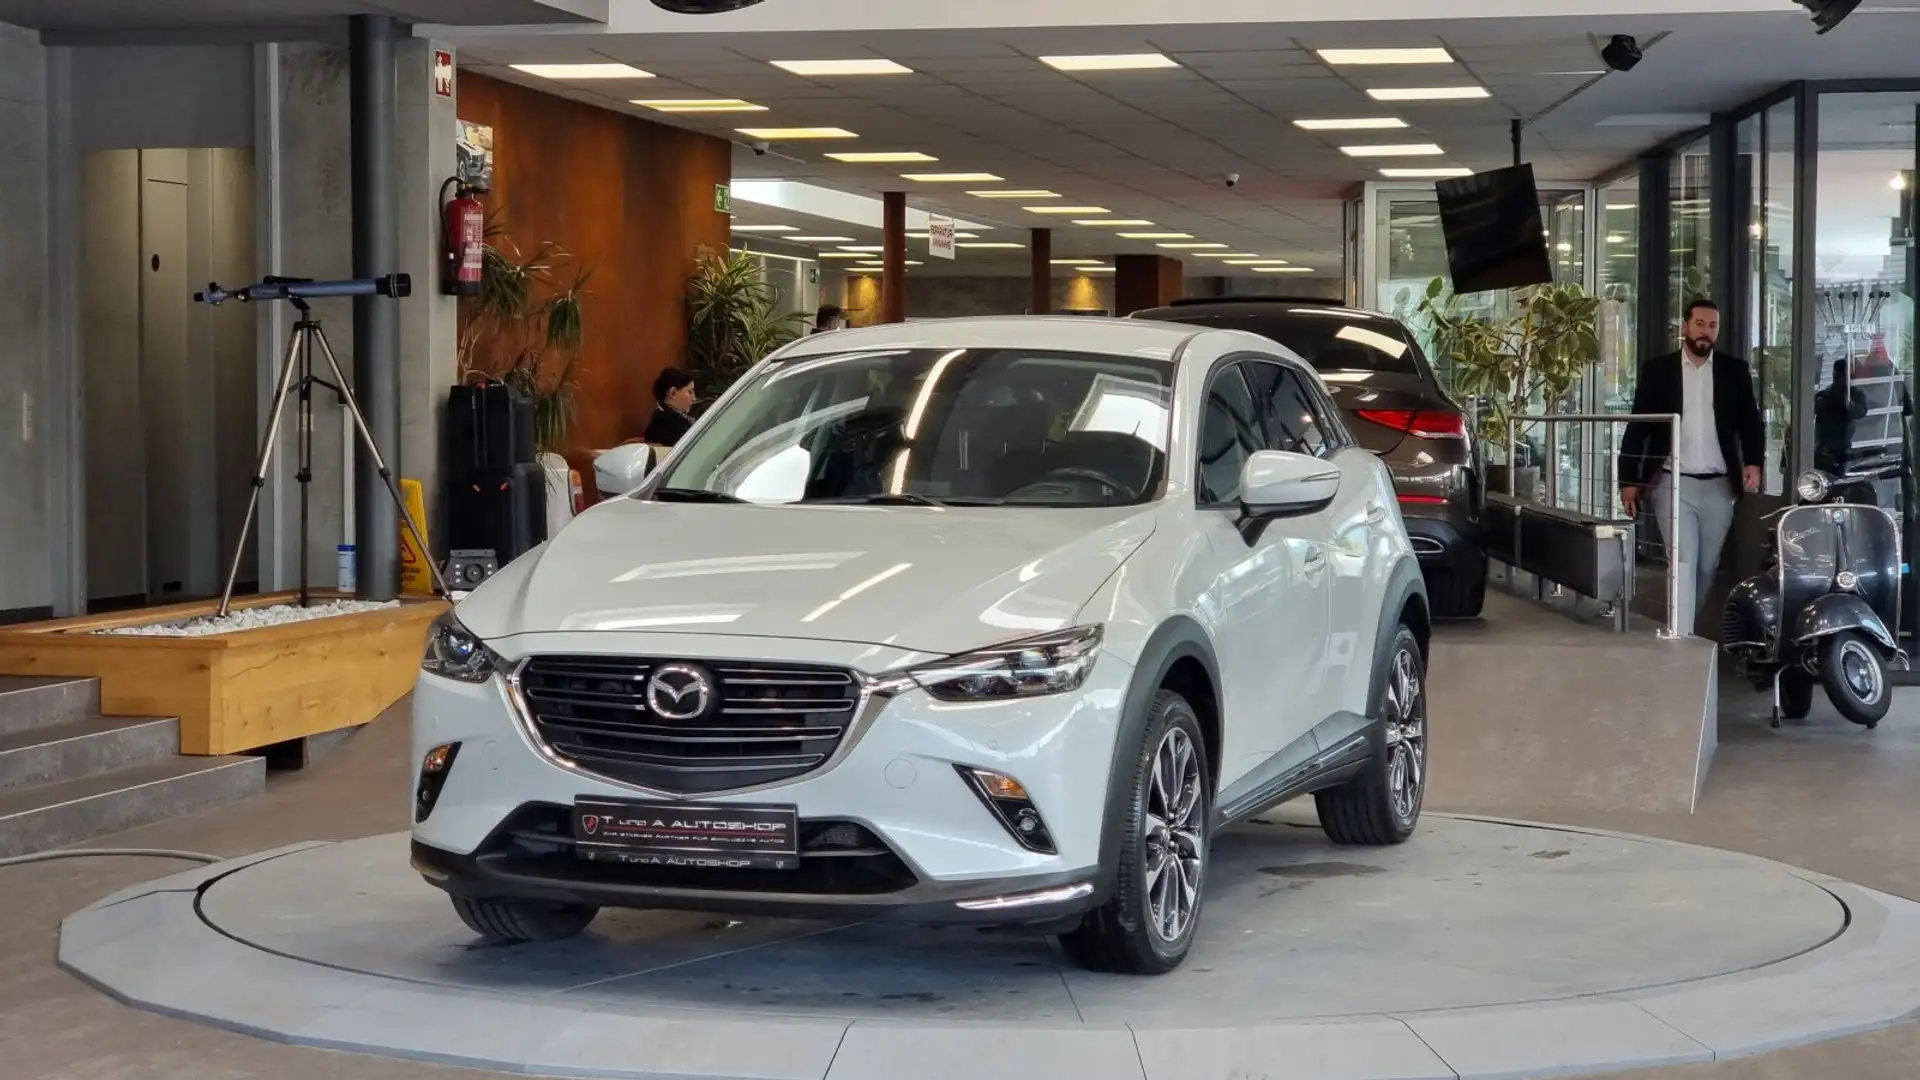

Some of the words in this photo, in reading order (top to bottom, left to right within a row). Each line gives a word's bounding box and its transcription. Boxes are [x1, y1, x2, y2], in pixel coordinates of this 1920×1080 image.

[601, 815, 614, 824] T
[652, 819, 665, 827] A
[671, 820, 787, 831] AUTOSHOP
[666, 857, 751, 868] AUTOSHOP
